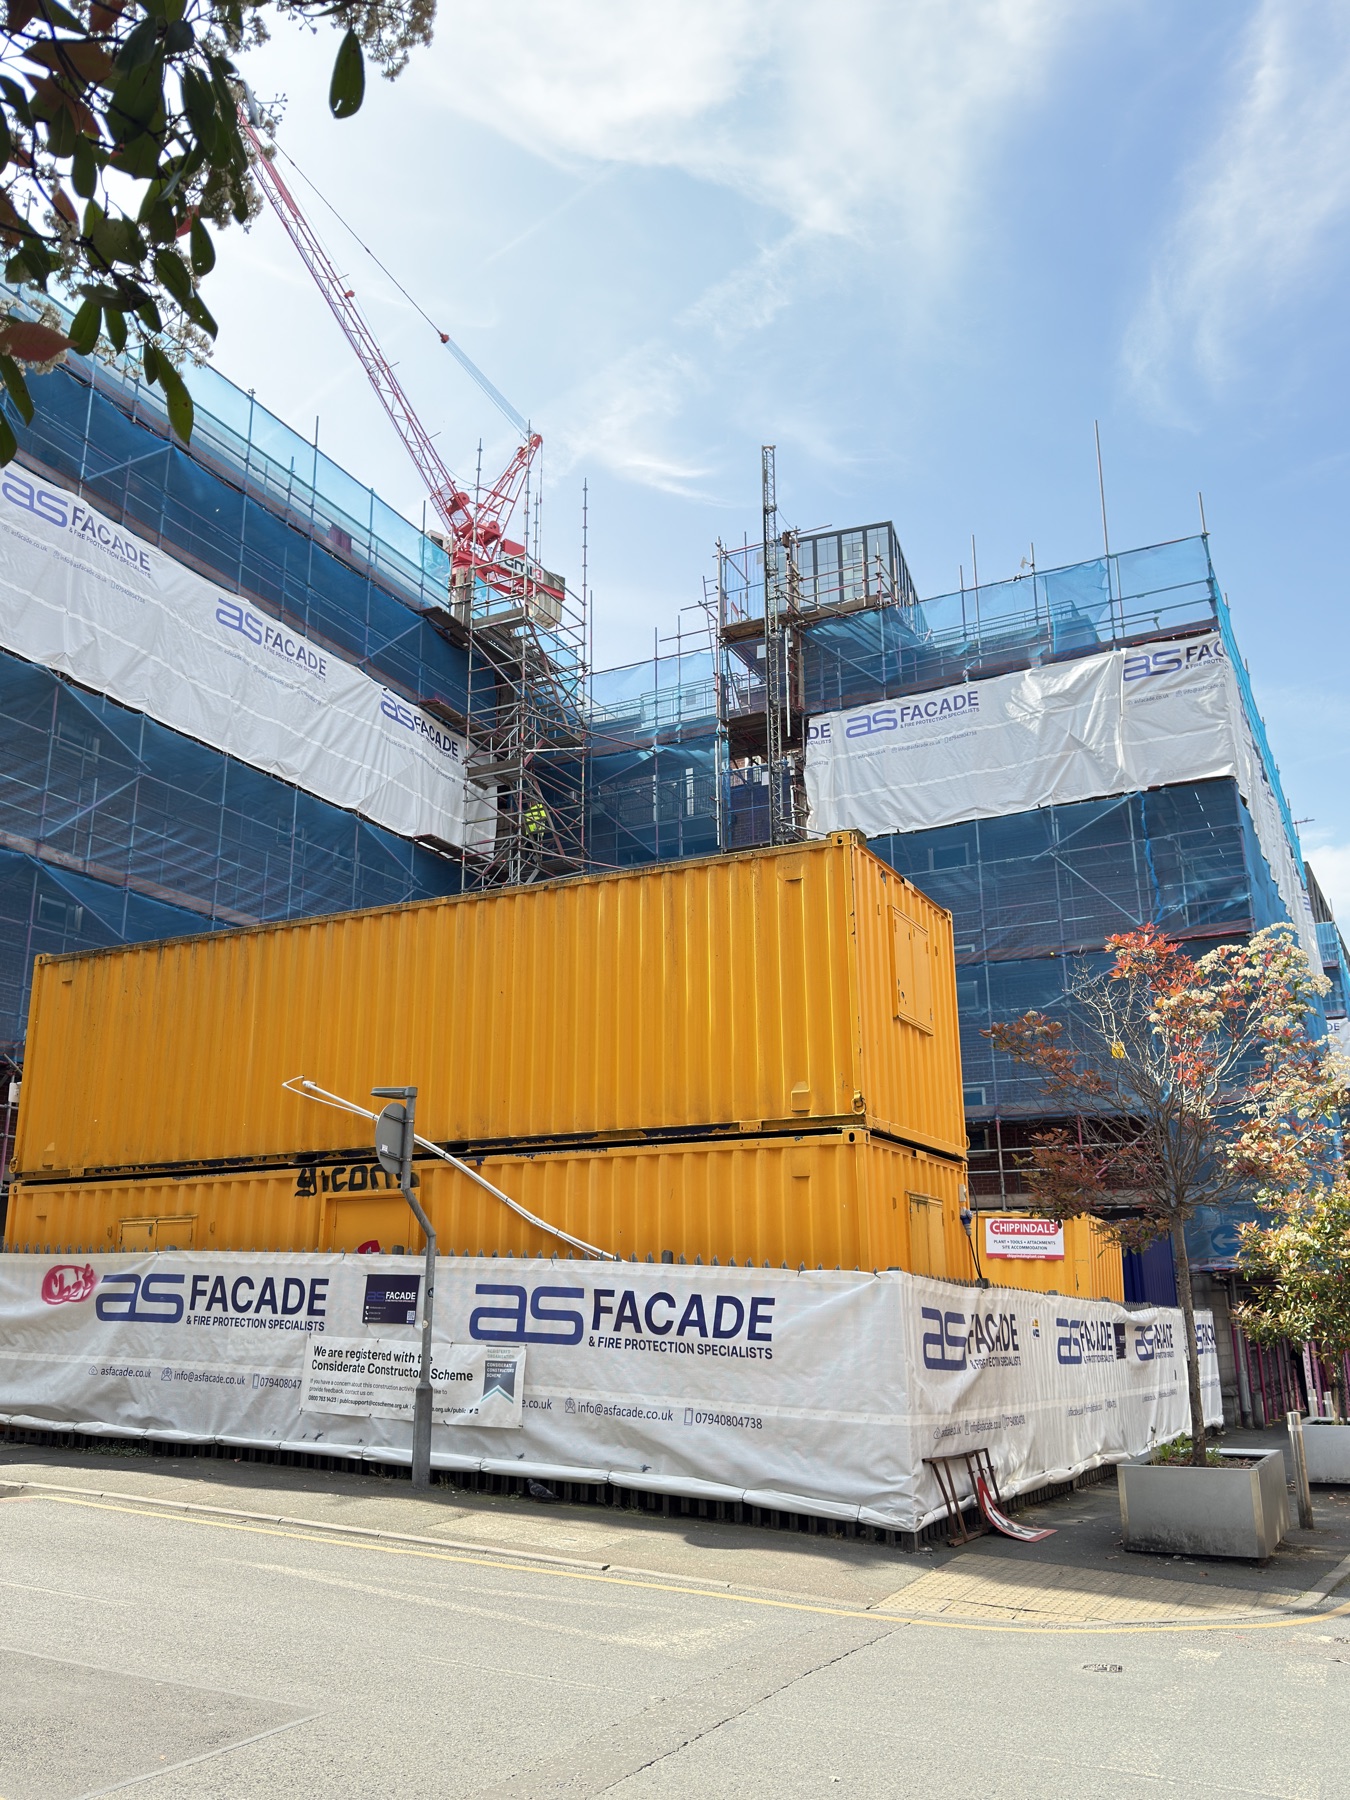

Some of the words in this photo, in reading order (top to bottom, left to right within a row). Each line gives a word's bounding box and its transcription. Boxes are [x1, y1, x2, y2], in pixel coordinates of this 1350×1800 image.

[2, 470, 69, 528] as
[71, 505, 151, 572] FACADE
[74, 530, 86, 540] FIRE
[86, 536, 119, 560] PROTECTION
[120, 556, 152, 579] SPECIALISTS
[215, 597, 263, 646] as
[264, 626, 327, 677] FACADE
[381, 692, 415, 731] as
[413, 715, 459, 758] FACADE
[846, 708, 898, 739] as
[900, 690, 979, 723] FACADE
[904, 720, 915, 728] FIRE
[915, 715, 948, 726] PROTECTION
[947, 708, 980, 719] SPECIALISTS
[992, 1222, 1055, 1234] CHIPPINDALE
[96, 1273, 186, 1324] as
[189, 1274, 330, 1317] FACADE
[385, 1291, 417, 1300] FACADE
[186, 1315, 192, 1325] &
[193, 1315, 212, 1326] FIRE
[212, 1316, 267, 1329] PROTECTION
[267, 1319, 325, 1332] SPECIALISTS
[469, 1284, 584, 1346] as
[591, 1288, 776, 1342] FACADE
[588, 1336, 596, 1347] &
[597, 1336, 622, 1349] FIRE
[624, 1338, 695, 1355] PROTECTION
[696, 1342, 773, 1360] SPECIALISTS
[921, 1306, 968, 1372] as
[313, 1345, 327, 1357] We
[328, 1349, 343, 1358] are
[345, 1348, 392, 1362] registered
[393, 1351, 415, 1364] with
[417, 1353, 433, 1365] te
[100, 1366, 152, 1379] asfacade.co.uk
[173, 1370, 246, 1386] info@asfacade.co.uk
[311, 1359, 366, 1374] Considerate
[430, 1368, 474, 1382] Scheme
[373, 1383, 399, 1391] construction
[399, 1385, 415, 1393] activity
[577, 1401, 674, 1422] info@asfacade.co.uk
[695, 1412, 763, 1430] 07940804738
